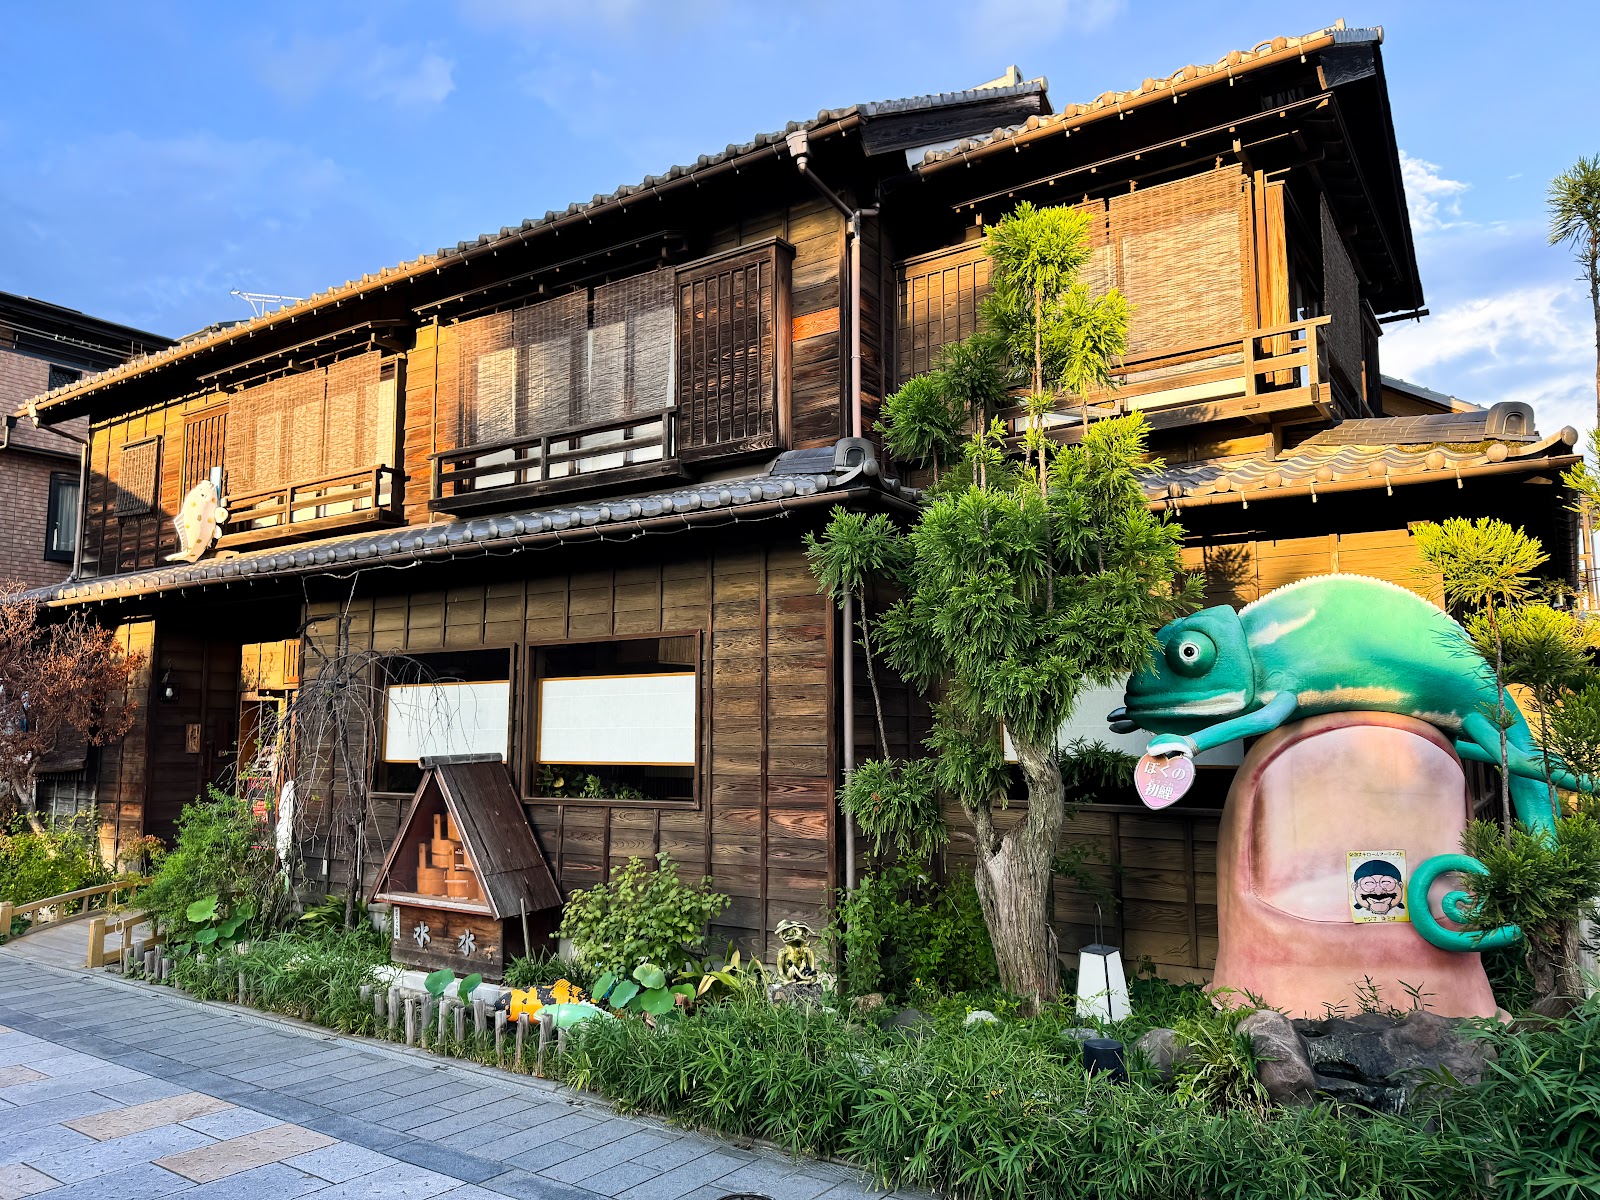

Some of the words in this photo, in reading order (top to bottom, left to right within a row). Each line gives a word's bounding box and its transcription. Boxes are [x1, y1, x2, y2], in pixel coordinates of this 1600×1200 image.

[1143, 761, 1186, 780] ぼくの
[413, 920, 431, 948] 水
[458, 928, 477, 957] 水
